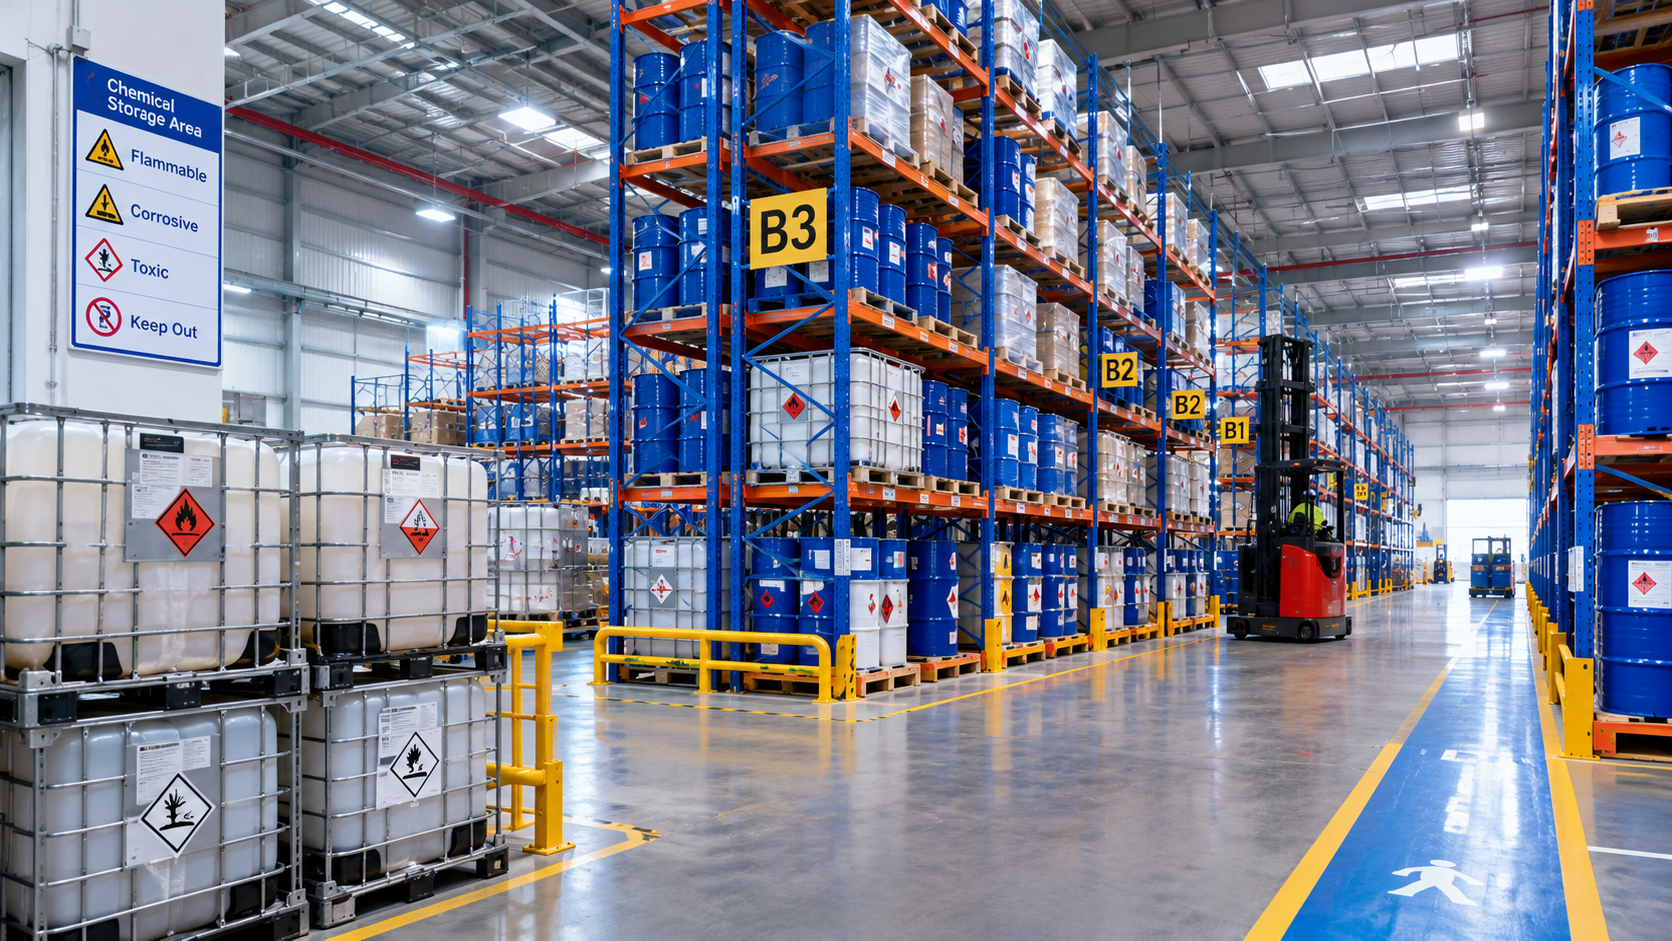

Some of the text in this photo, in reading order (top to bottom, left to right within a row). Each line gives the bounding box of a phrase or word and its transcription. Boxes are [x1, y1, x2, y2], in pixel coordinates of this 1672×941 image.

[107, 78, 175, 113] Chemical
[107, 96, 203, 138] Storage Area
[131, 148, 207, 183] Flammable
[131, 204, 199, 233] Corrosive
[761, 204, 816, 255] B3
[131, 259, 169, 279] Toxic
[131, 315, 198, 339] Keep Out
[1106, 358, 1134, 381] B2
[1175, 395, 1200, 415] B2
[1224, 421, 1245, 439] B1
